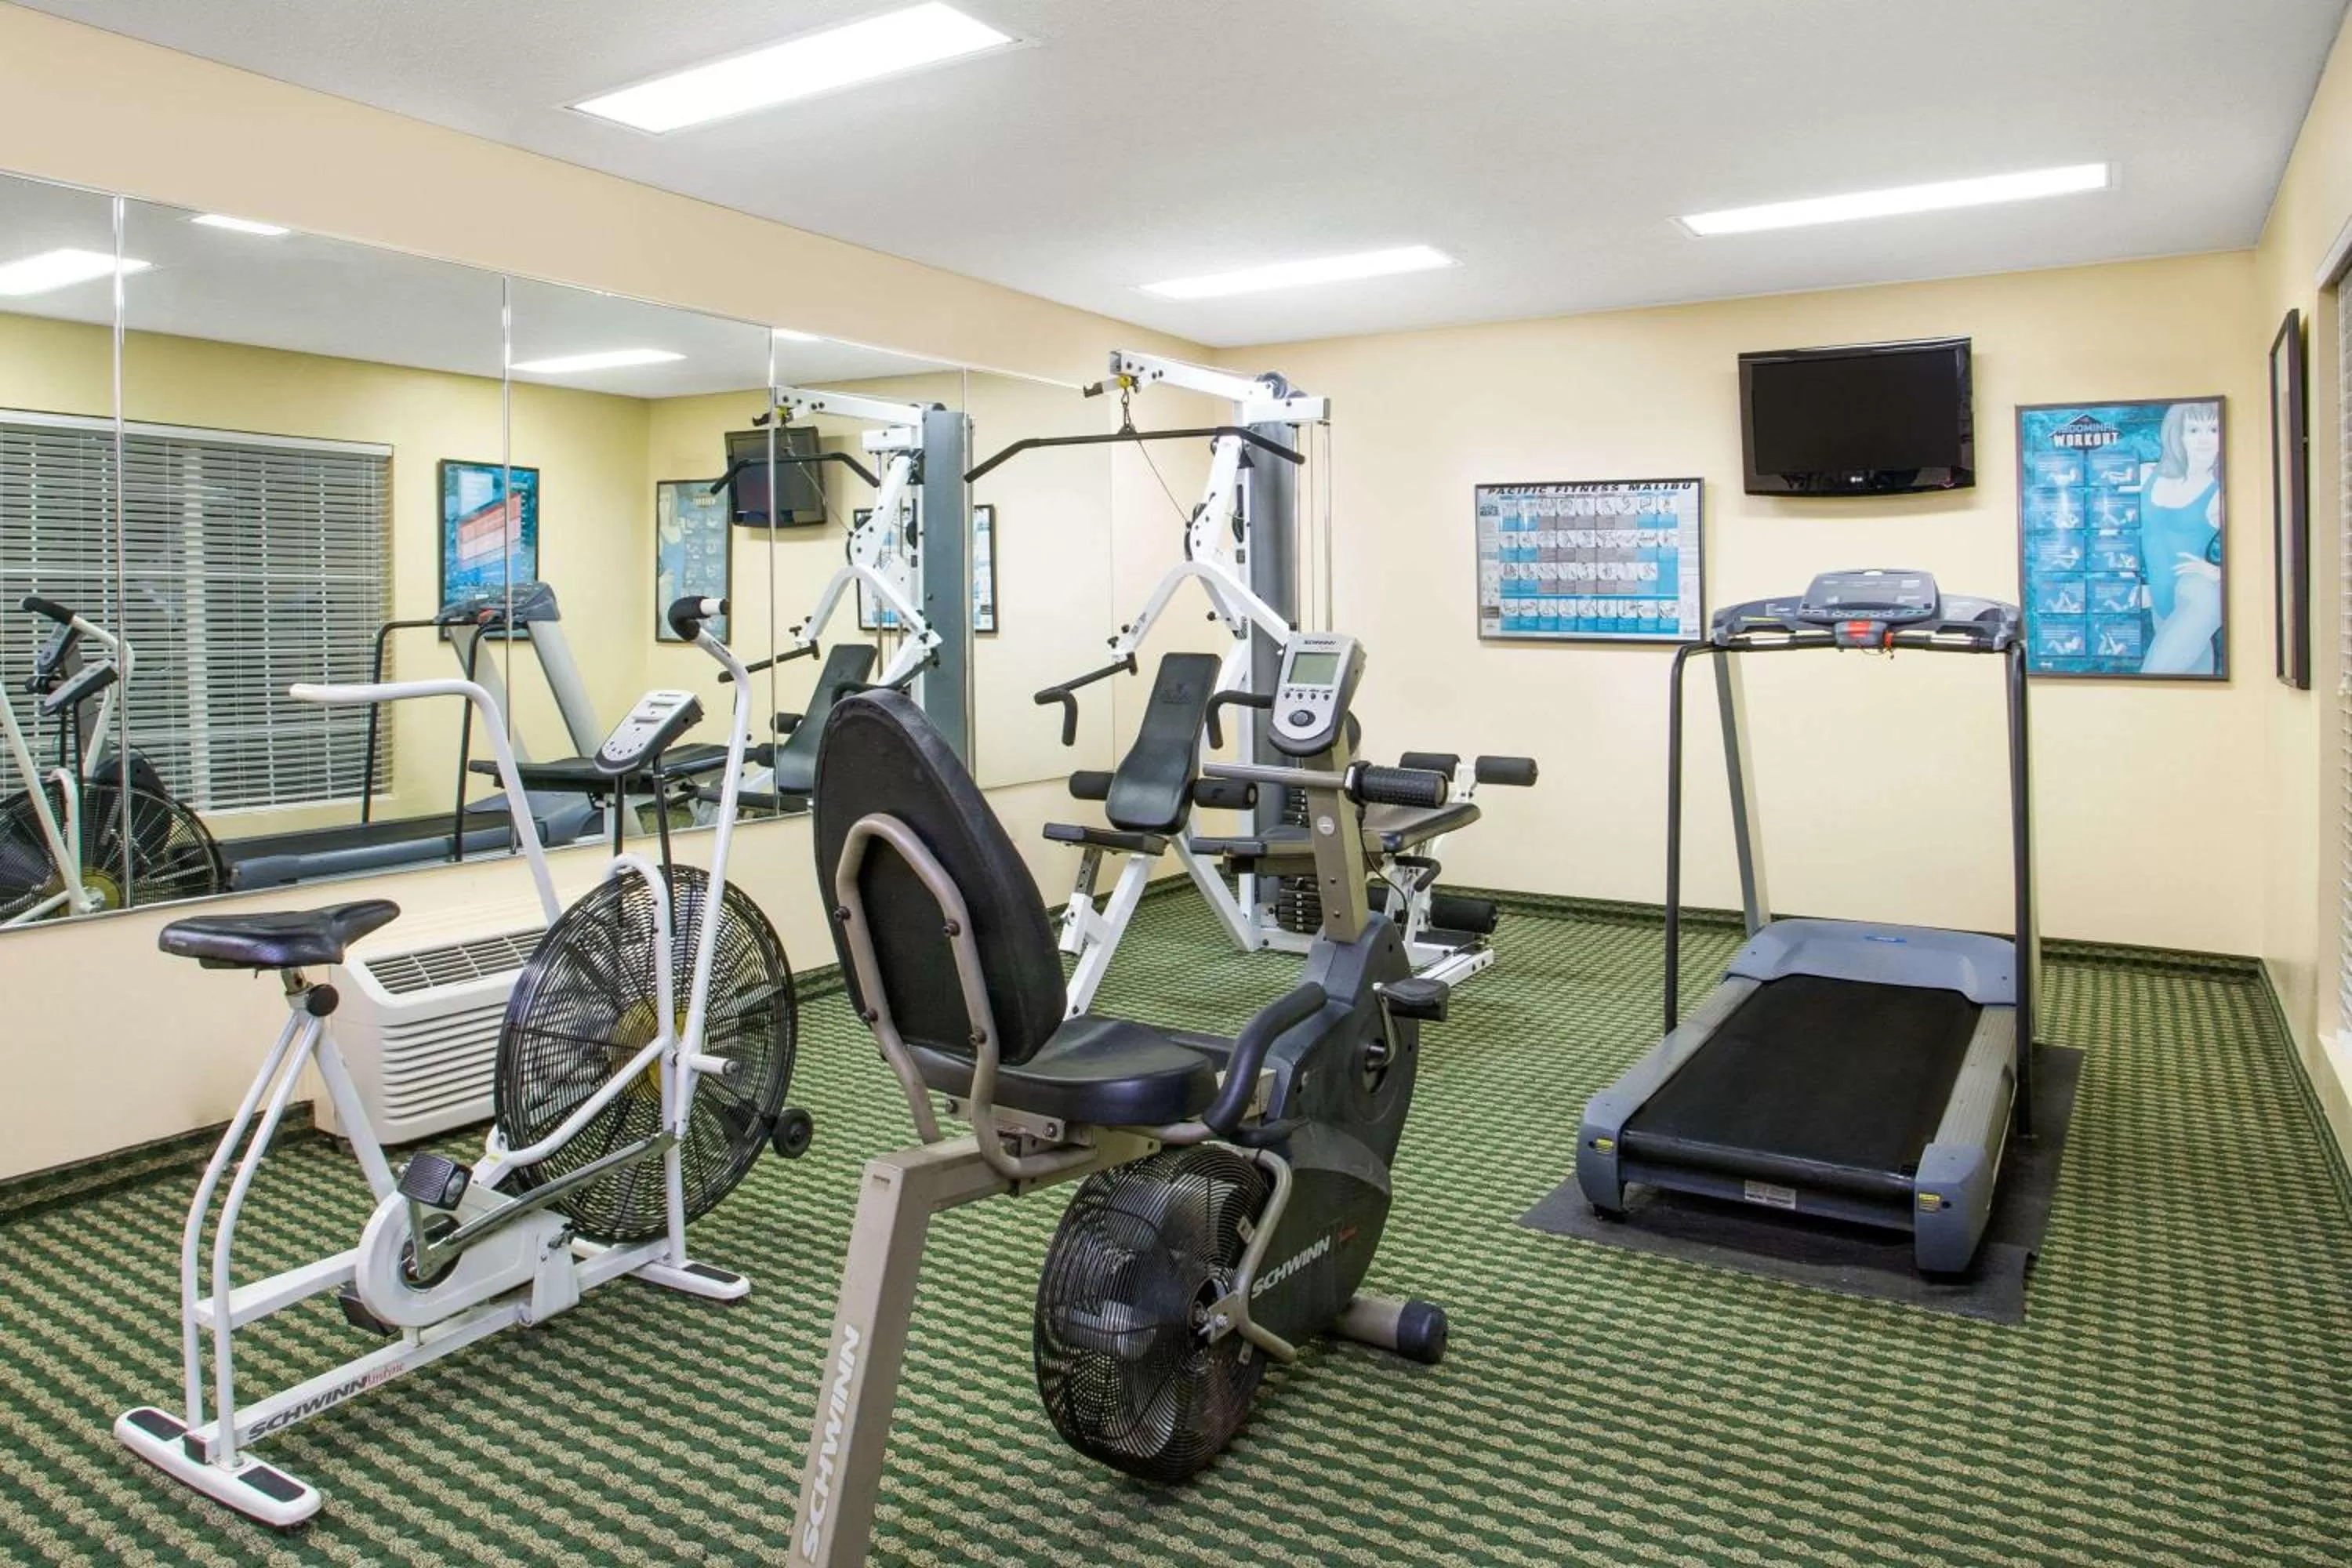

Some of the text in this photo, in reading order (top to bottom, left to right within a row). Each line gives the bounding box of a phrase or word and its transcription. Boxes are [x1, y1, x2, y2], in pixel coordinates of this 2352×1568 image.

[2053, 432, 2119, 448] WORKOUT
[1487, 482, 1691, 495] PACIFIC FITNESS MALIBU
[1251, 1235, 1331, 1300] SCHWINN
[248, 1376, 367, 1440] SCHWINN
[801, 1323, 860, 1563] SCHWINN
